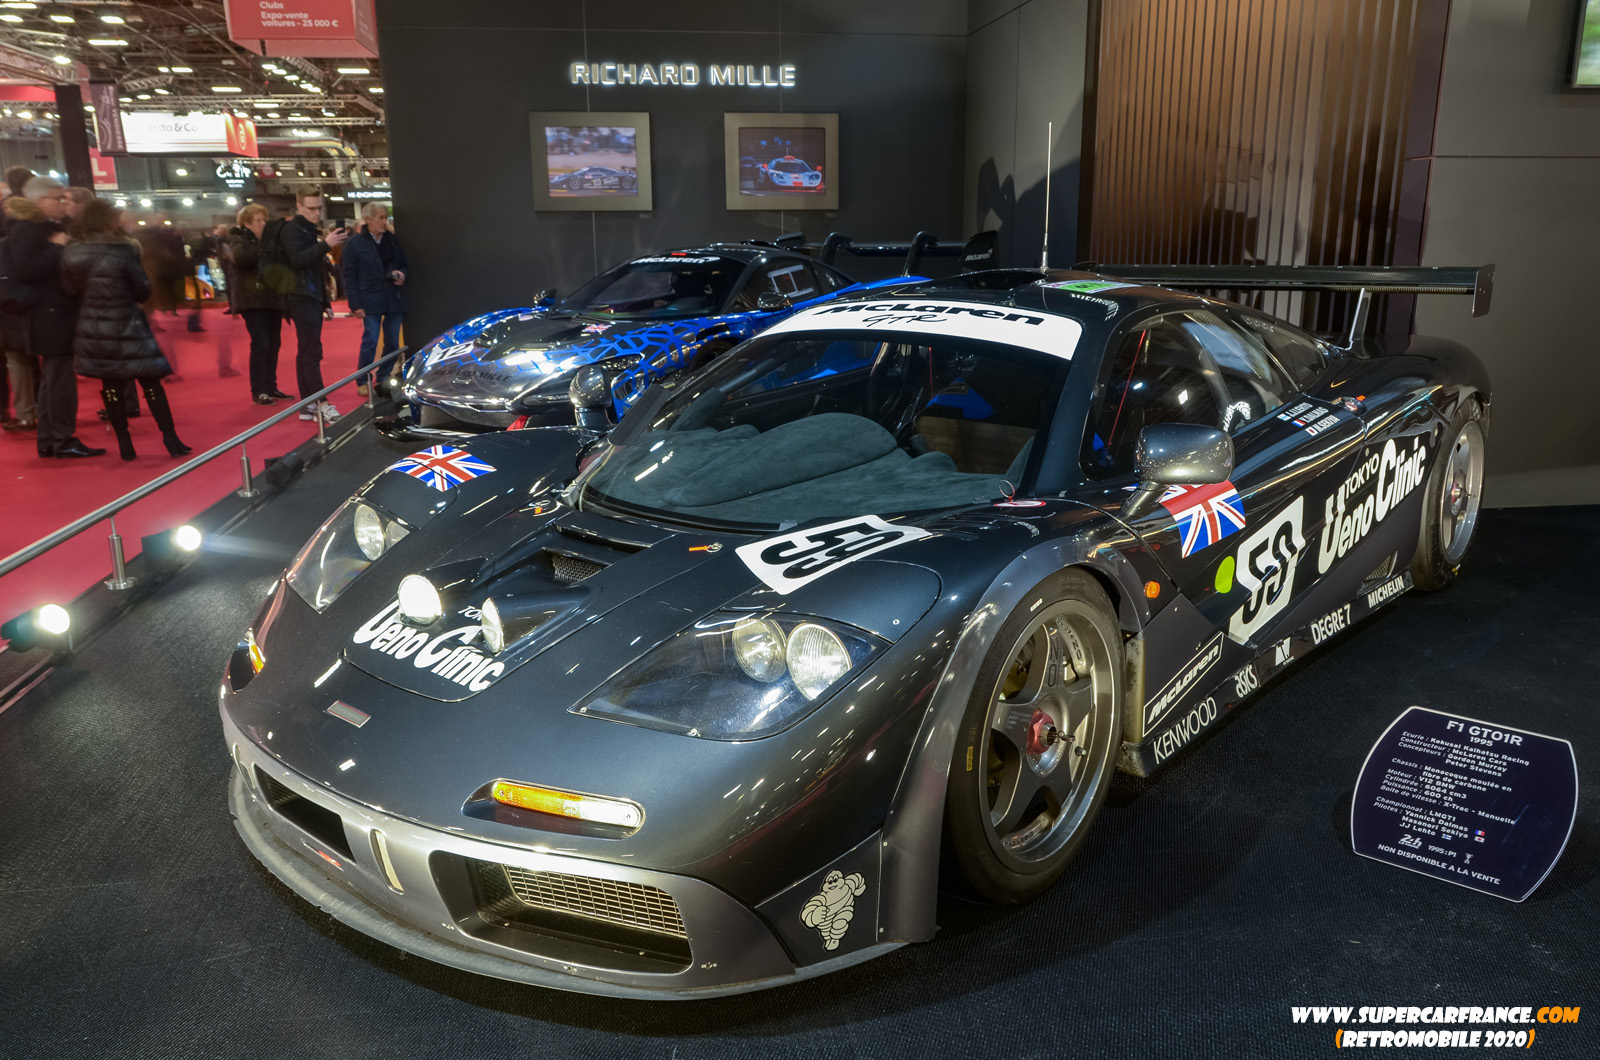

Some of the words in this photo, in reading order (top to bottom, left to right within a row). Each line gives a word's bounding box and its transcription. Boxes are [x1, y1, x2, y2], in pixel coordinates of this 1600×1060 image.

[259, 1, 284, 9] Clubs
[260, 11, 309, 20] Expo-vente
[261, 19, 296, 27] voitures
[302, 19, 313, 27] 25
[314, 19, 330, 27] 000
[331, 19, 339, 27] €
[569, 62, 700, 86] RICHARD
[710, 63, 796, 87] MILLE
[811, 303, 1045, 326] McLaren
[1345, 453, 1380, 499] TOKYO
[1318, 484, 1375, 574] Ueno
[1375, 437, 1426, 522] Clinic
[1367, 575, 1405, 608] MICHELIN
[1310, 609, 1345, 645] DEGRE
[1343, 604, 1351, 625] 7
[1147, 644, 1219, 724] McLaren
[1153, 696, 1217, 764] KENWOOD
[1446, 720, 1465, 732] F1
[1400, 736, 1446, 751] Constructeur
[1452, 749, 1486, 761] McLaren
[1488, 757, 1507, 766] Cars
[1402, 731, 1425, 740] Ecurie
[1430, 737, 1461, 749] Kokusai
[1463, 745, 1500, 758] Kaihatsu
[1501, 754, 1530, 766] Racing
[1470, 736, 1493, 747] 1995
[1398, 741, 1441, 756] Concepteurs
[1447, 753, 1476, 765] Gordon
[1478, 760, 1507, 773] Murray
[1445, 758, 1468, 769] Peter
[1469, 764, 1502, 777] Stevens
[1385, 773, 1419, 787] Cylindrée
[1424, 784, 1447, 794] 6064
[1449, 791, 1467, 799] cm3
[1386, 768, 1412, 779] Moteur
[1419, 776, 1434, 784] V12
[1435, 780, 1456, 790] BMW
[1391, 757, 1418, 769] Chassis
[1424, 765, 1468, 781] Monocoque
[1470, 777, 1500, 789] moulée
[1422, 771, 1441, 781] fibre
[1454, 780, 1487, 792] carbone
[1382, 779, 1418, 793] Puissance
[1424, 790, 1442, 799] 600
[1373, 801, 1398, 813] Pilotes
[1405, 809, 1436, 823] Yannick
[1438, 818, 1469, 832] Dalmas
[1376, 796, 1423, 813] Championnat
[1429, 810, 1456, 822] LMGT1
[1411, 793, 1437, 804] vitesse
[1477, 810, 1516, 825] Manuelle
[1401, 815, 1439, 830] Masanori
[1440, 826, 1469, 839] Sekiya
[1412, 825, 1436, 836] Lehto
[1377, 843, 1396, 854] NON
[1397, 849, 1447, 869] DISPONIBLE
[1456, 867, 1469, 876] LA
[1471, 870, 1501, 885] VENTE
